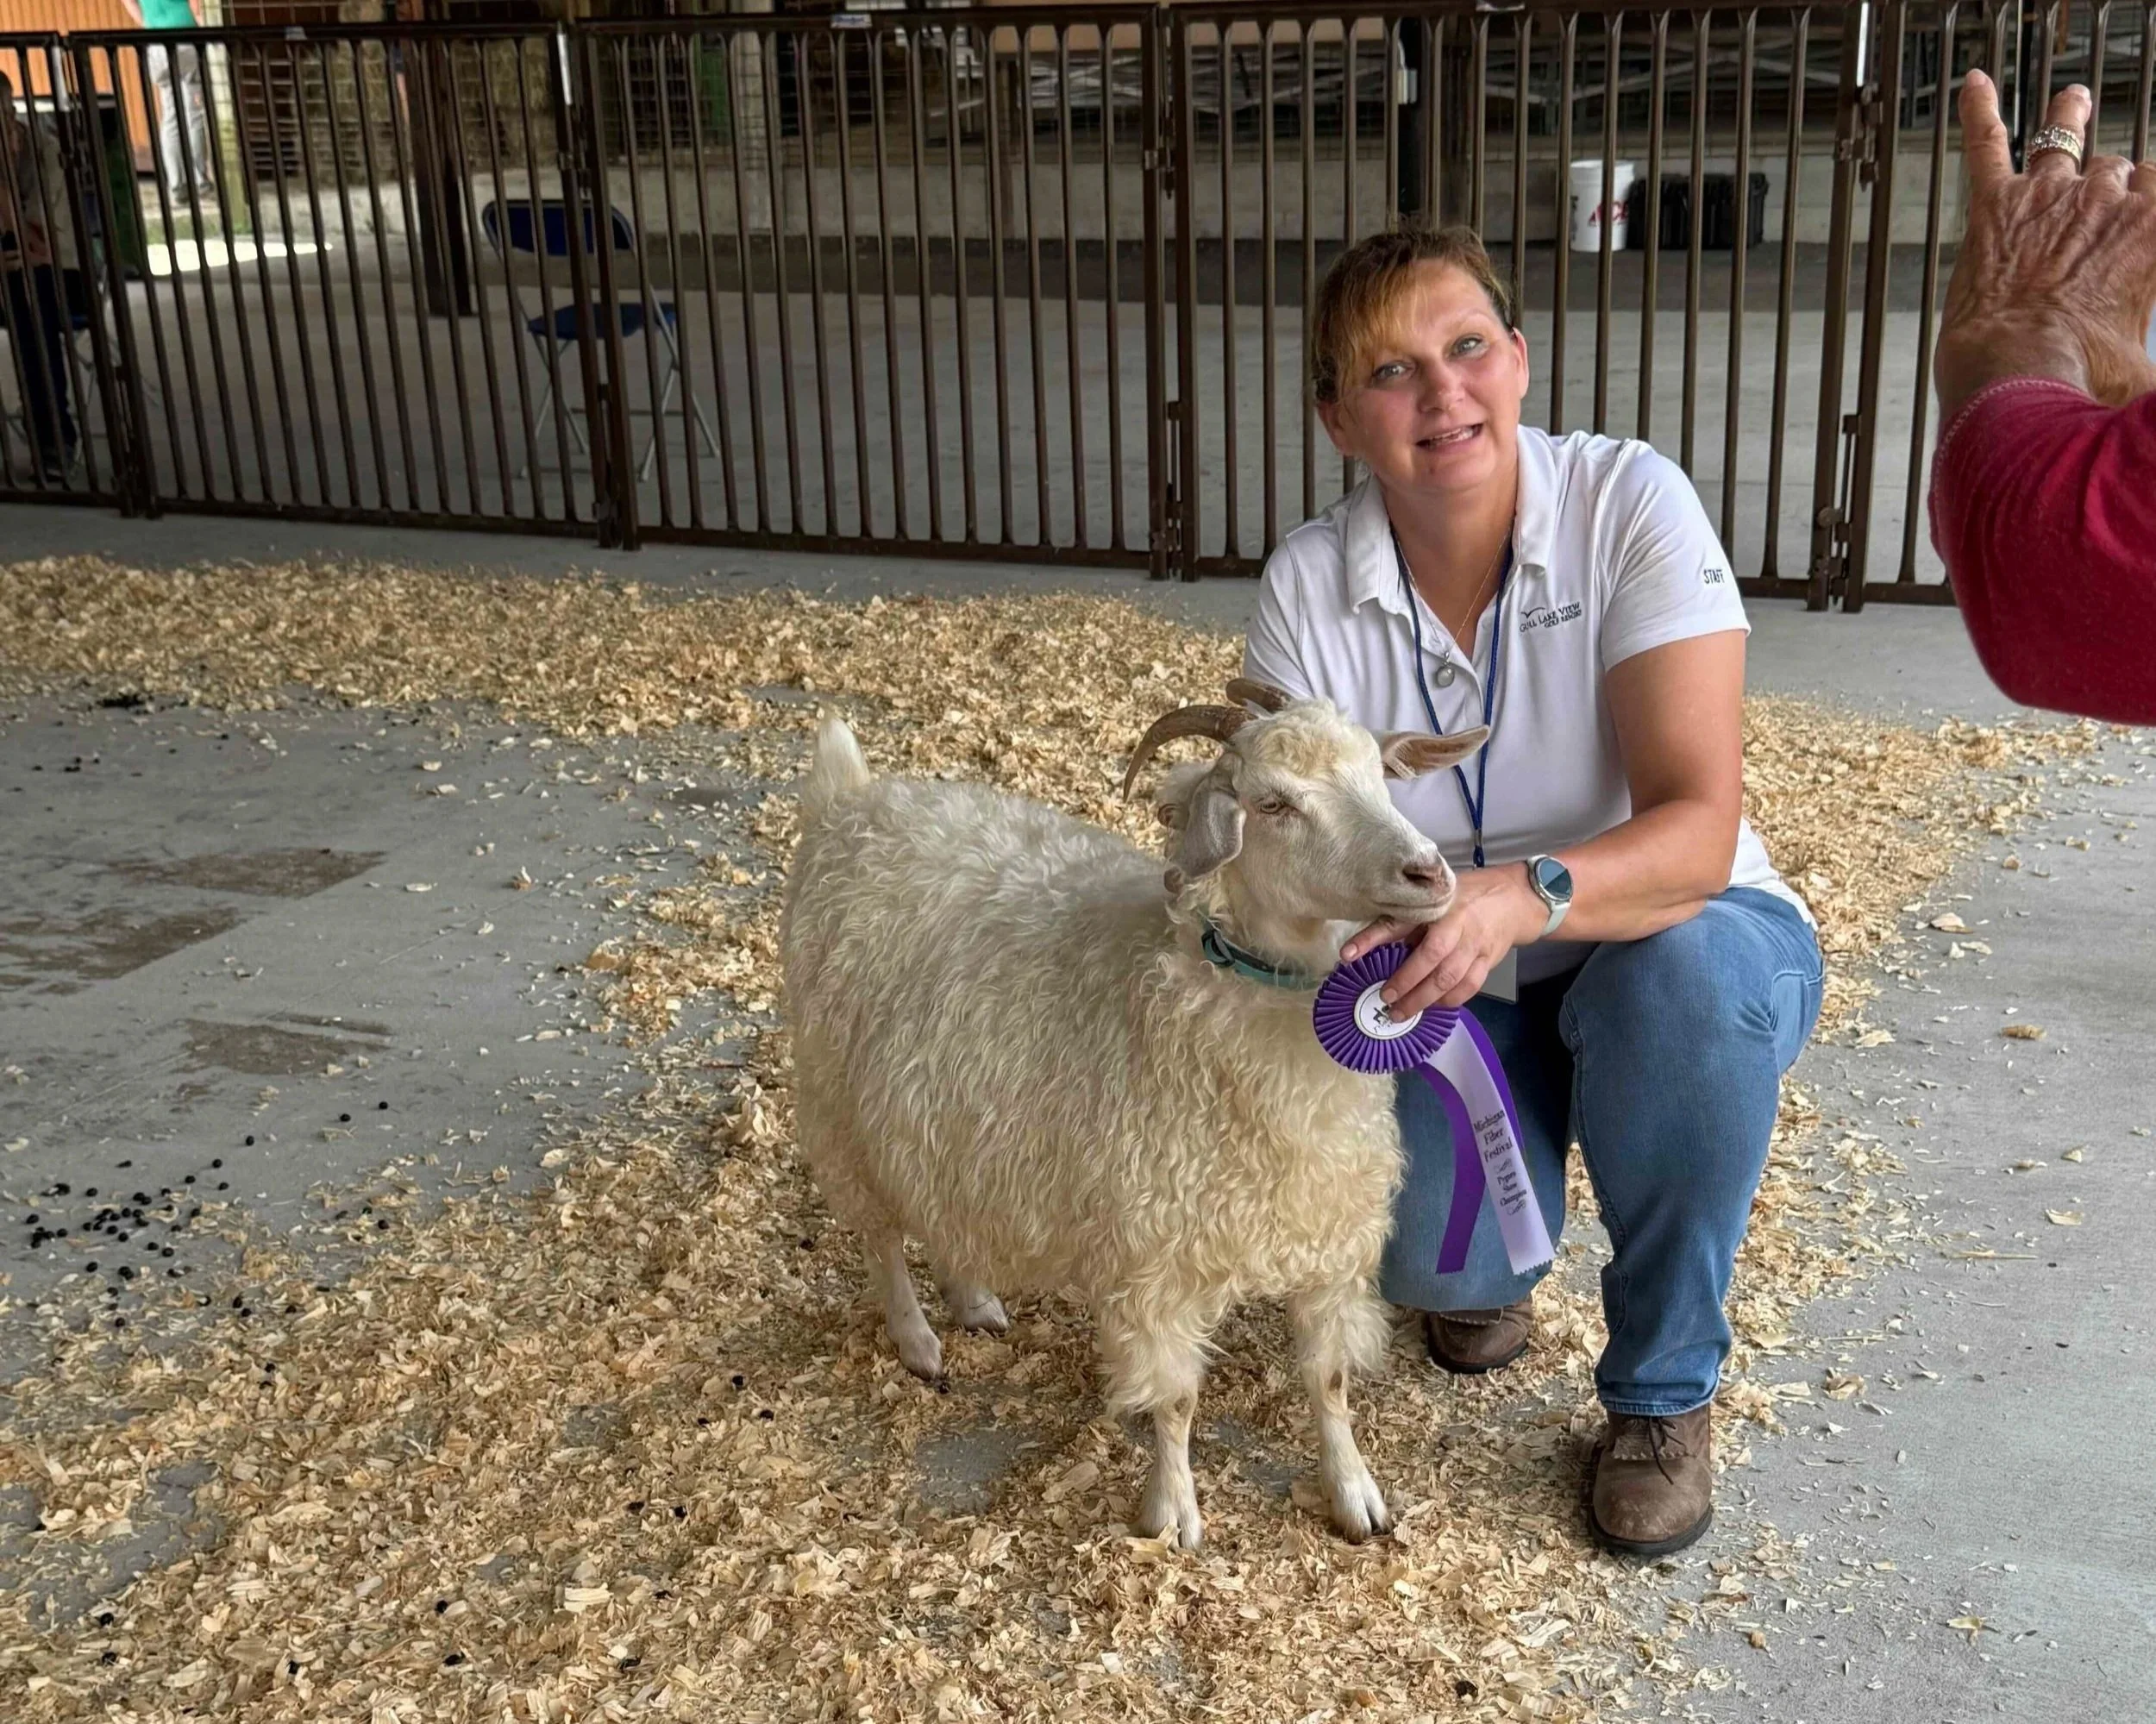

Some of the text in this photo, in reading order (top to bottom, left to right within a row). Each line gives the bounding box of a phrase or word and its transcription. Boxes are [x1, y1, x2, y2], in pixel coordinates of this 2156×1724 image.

[1703, 568, 1725, 585] STAFF
[1519, 601, 1580, 633] GULL LAKE VIEW
[1483, 1128, 1504, 1145] Fiber
[1483, 1136, 1514, 1163] Festival
